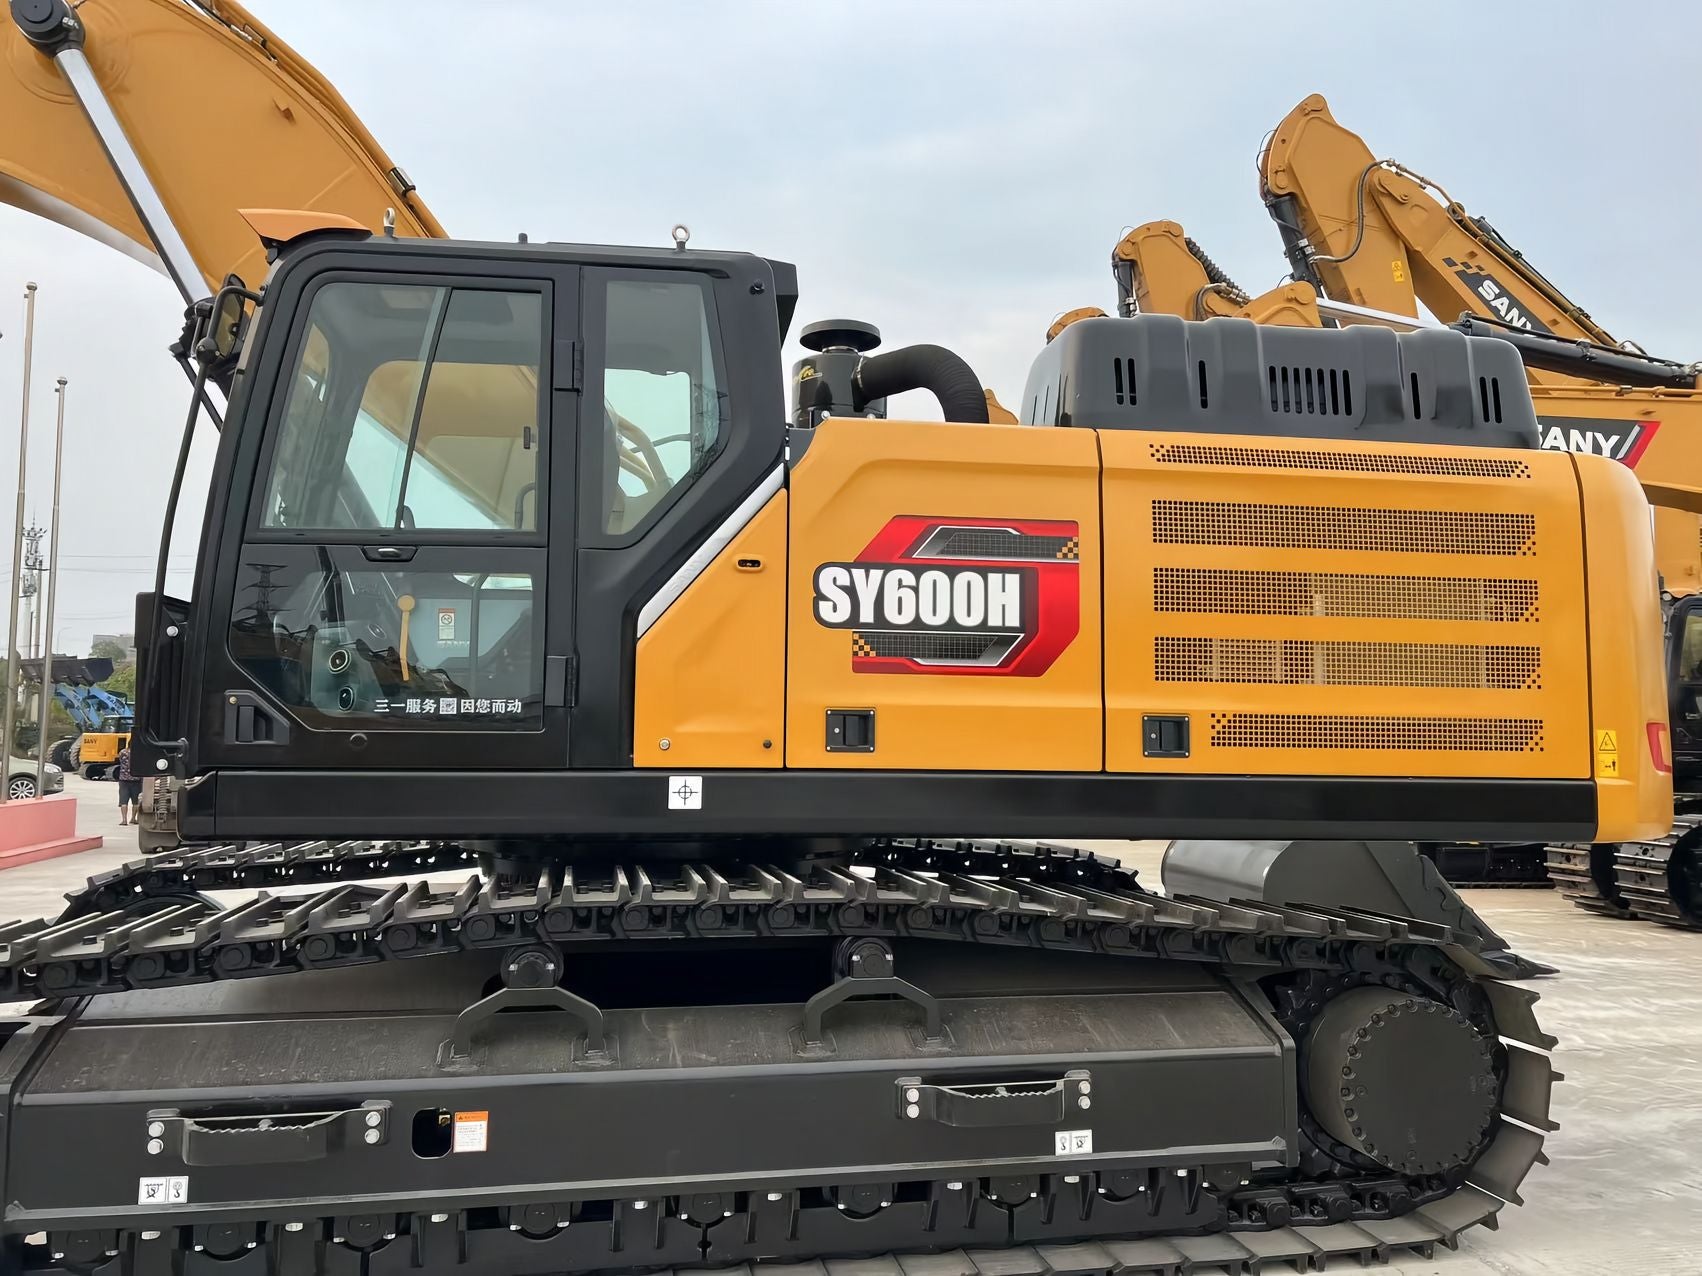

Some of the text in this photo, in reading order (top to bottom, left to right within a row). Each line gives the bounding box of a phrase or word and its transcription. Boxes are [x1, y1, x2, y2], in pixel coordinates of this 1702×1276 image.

[1538, 424, 1620, 457] ANY
[818, 566, 1020, 627] SY600H
[374, 698, 522, 714] 三一服务 因您而动
